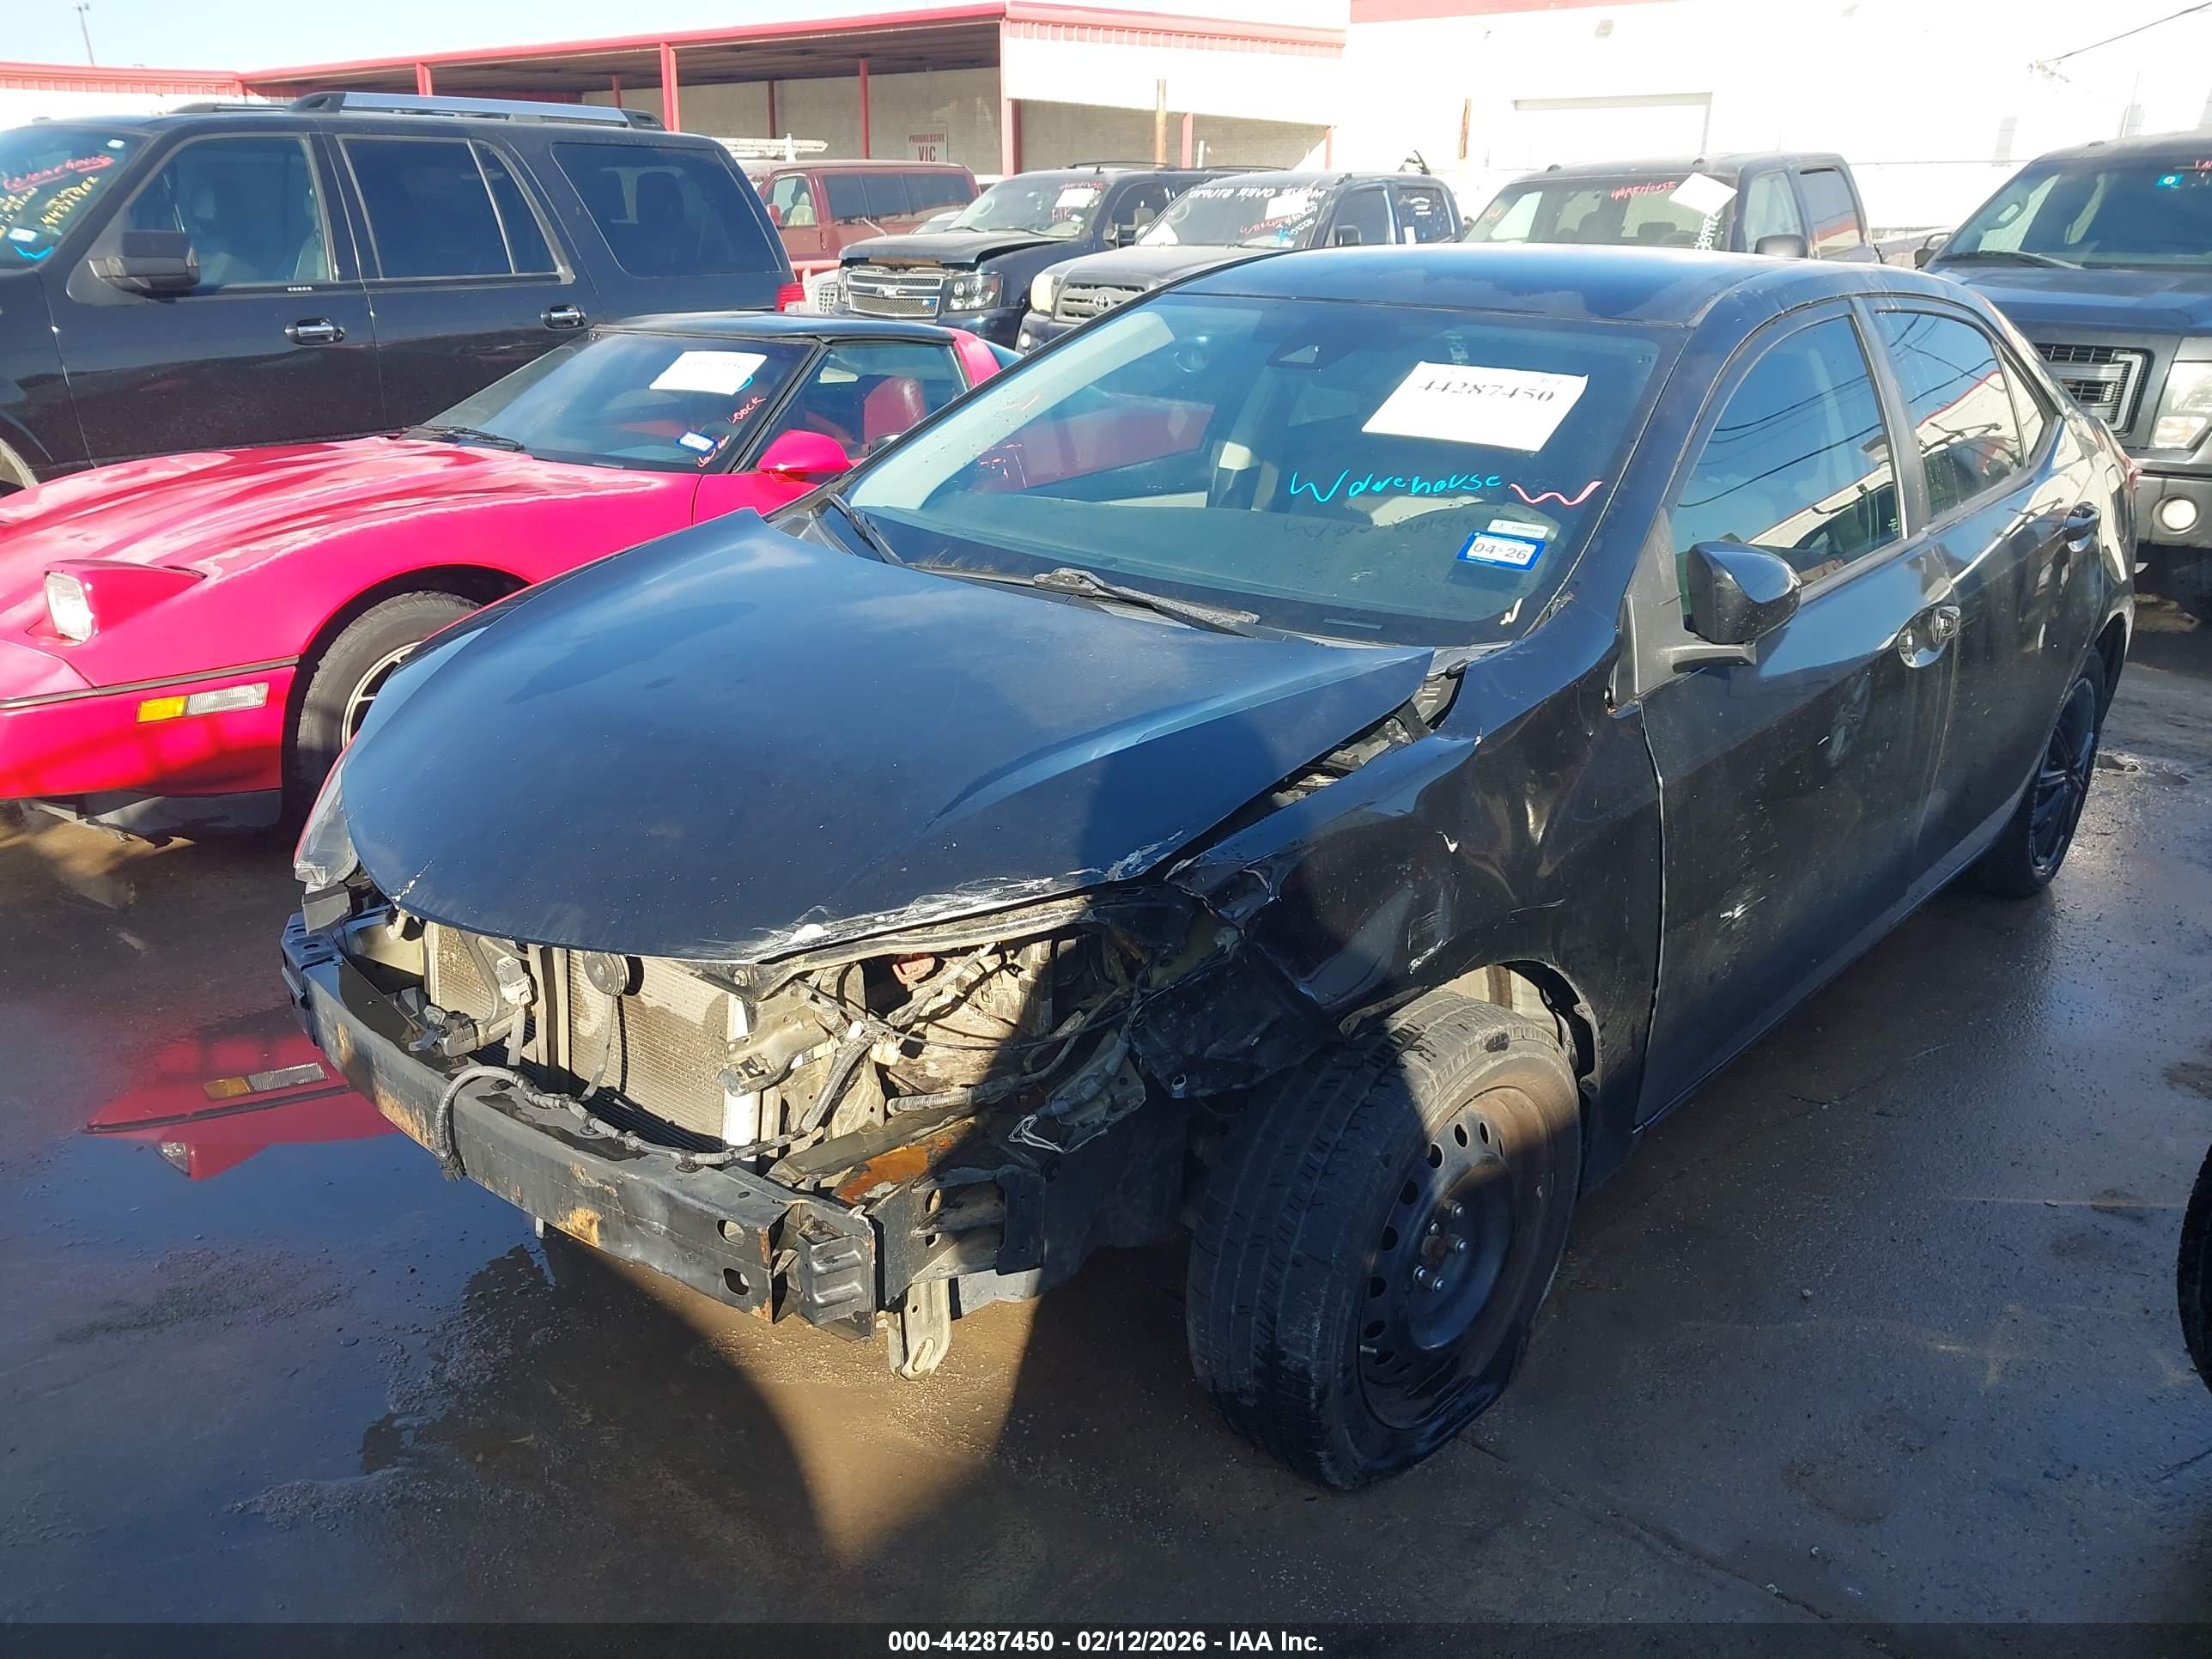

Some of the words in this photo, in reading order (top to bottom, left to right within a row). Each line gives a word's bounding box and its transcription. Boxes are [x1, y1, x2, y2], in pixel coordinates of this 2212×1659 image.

[908, 133, 945, 143] PROGRESSIVE
[918, 145, 936, 162] VIC
[1418, 379, 1555, 404] 44287450
